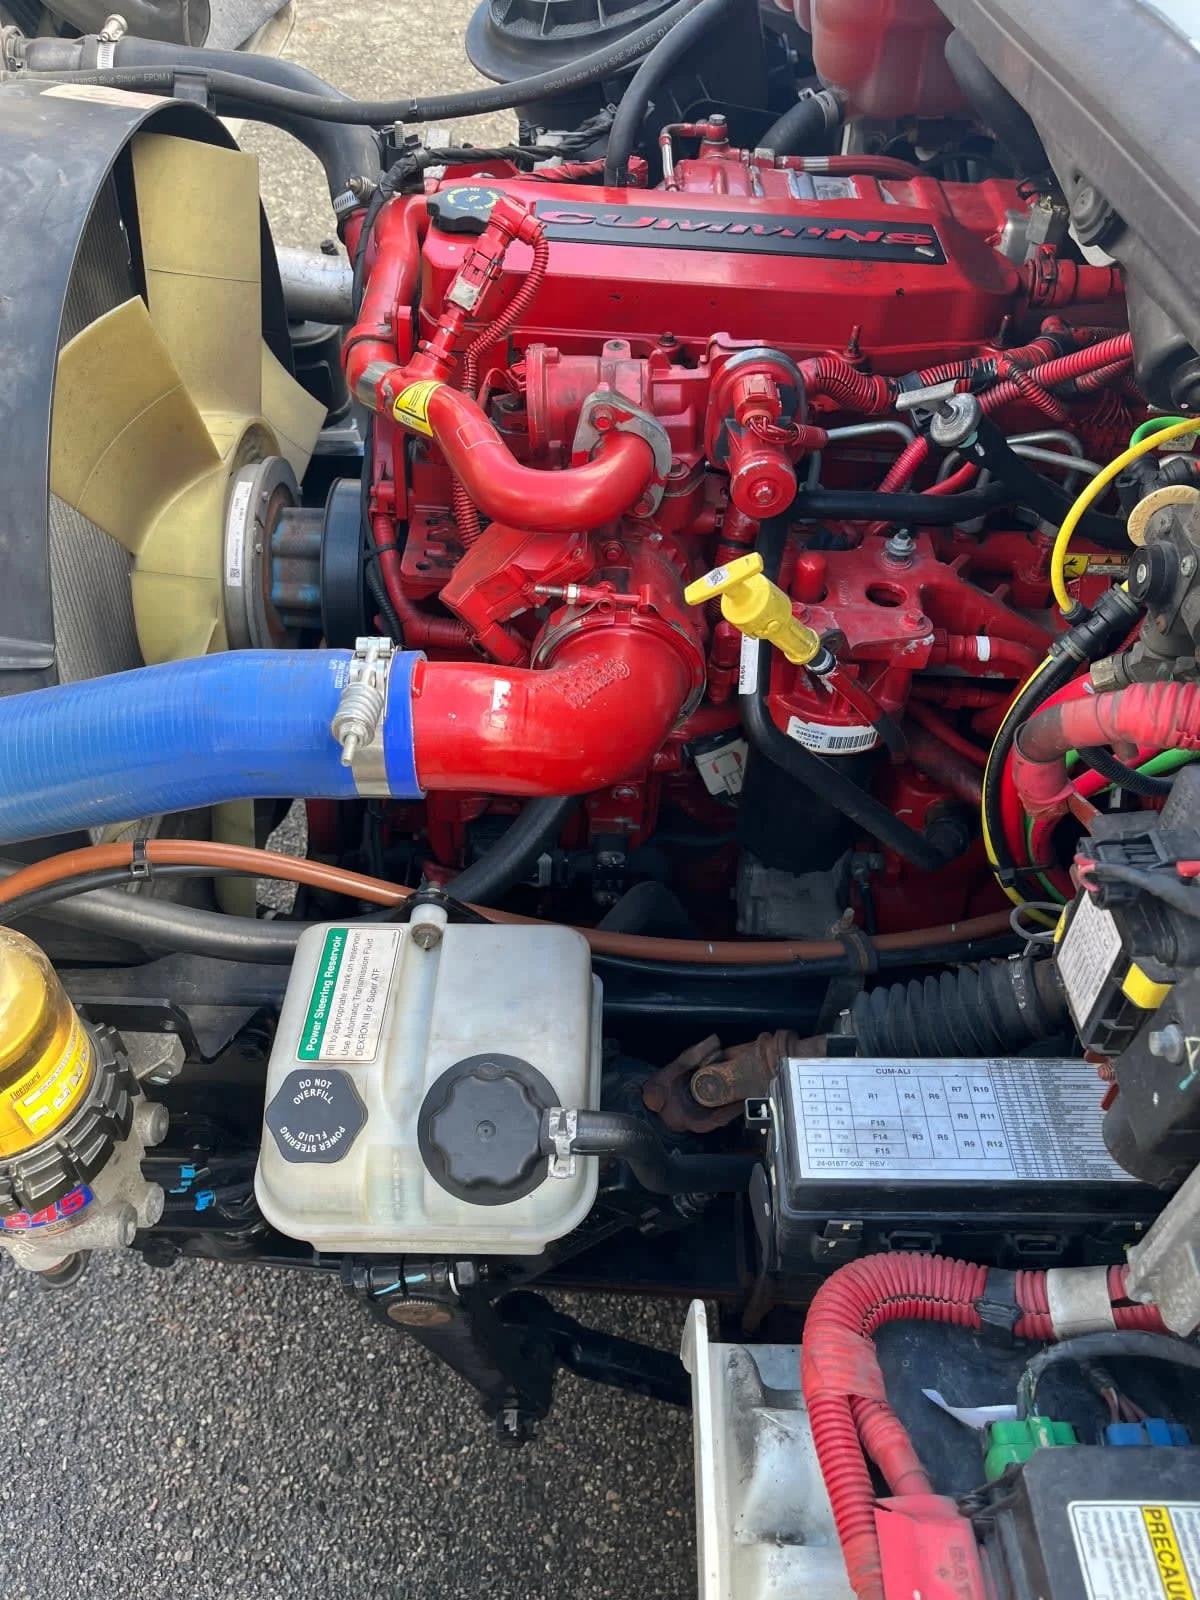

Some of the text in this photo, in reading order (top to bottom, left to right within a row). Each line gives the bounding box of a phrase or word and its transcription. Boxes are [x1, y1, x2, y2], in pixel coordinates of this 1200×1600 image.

[537, 209, 934, 246] CUMMINS
[372, 968, 381, 982] ATF
[305, 935, 343, 1052] Power Steering Reservoir
[341, 938, 374, 1056] Use Automatic Transmission Fluid
[367, 982, 378, 1005] Super
[326, 1044, 337, 1056] Fill
[333, 992, 347, 1034] appropriate
[342, 973, 351, 992] mark
[355, 1021, 369, 1056] DEXRON
[875, 1067, 911, 1075] CUM-ALI
[298, 1078, 333, 1090] DO NOT
[293, 1088, 334, 1105] OVERFILL
[868, 1092, 879, 1100] R1
[904, 1092, 916, 1100] R4
[928, 1092, 940, 1100] R6
[280, 1126, 346, 1153] POWER STEERING
[298, 1131, 328, 1143] FLUID
[872, 1133, 888, 1141] F14
[912, 1133, 924, 1141] R3
[937, 1133, 949, 1141] R5
[963, 1140, 975, 1148] R9
[986, 1140, 1003, 1148] R12
